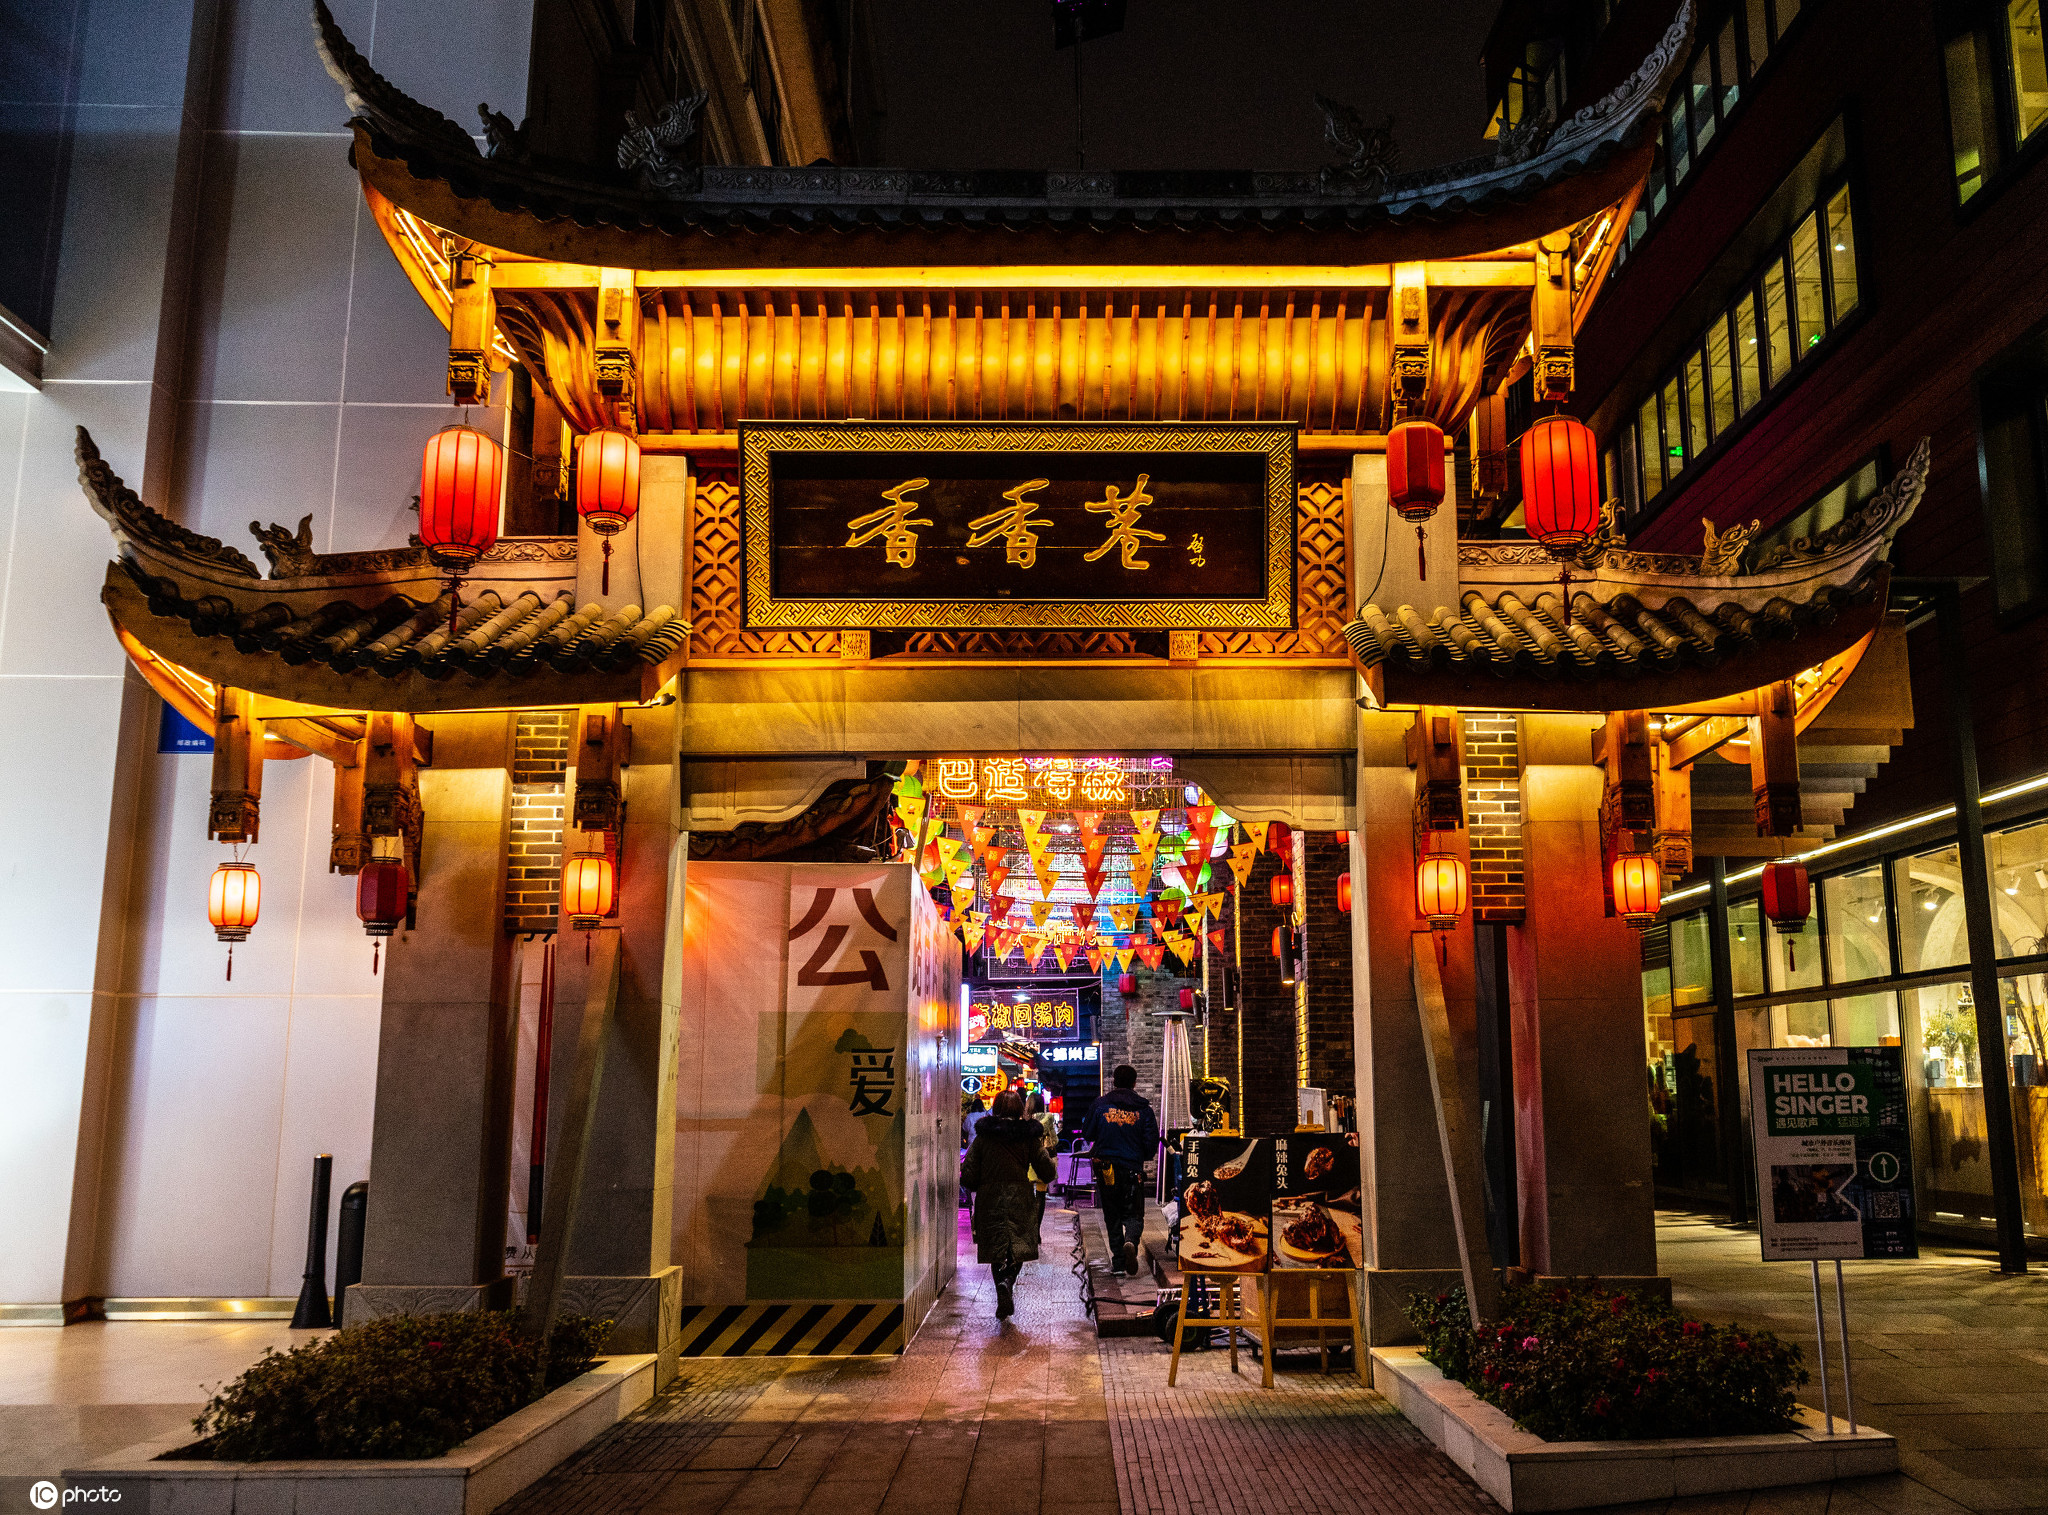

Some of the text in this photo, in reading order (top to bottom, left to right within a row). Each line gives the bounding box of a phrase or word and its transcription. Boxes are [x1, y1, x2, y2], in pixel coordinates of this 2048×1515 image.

[845, 473, 1166, 569] 香香巷
[789, 888, 897, 991] 公
[849, 1047, 895, 1117] 爱
[1773, 1072, 1855, 1093] HELLO
[1774, 1094, 1869, 1116] SINGER
[1776, 1117, 1818, 1128] 遇见歌声
[1186, 1140, 1200, 1178] 手撕兔
[1275, 1139, 1289, 1189] 麻辣兔头
